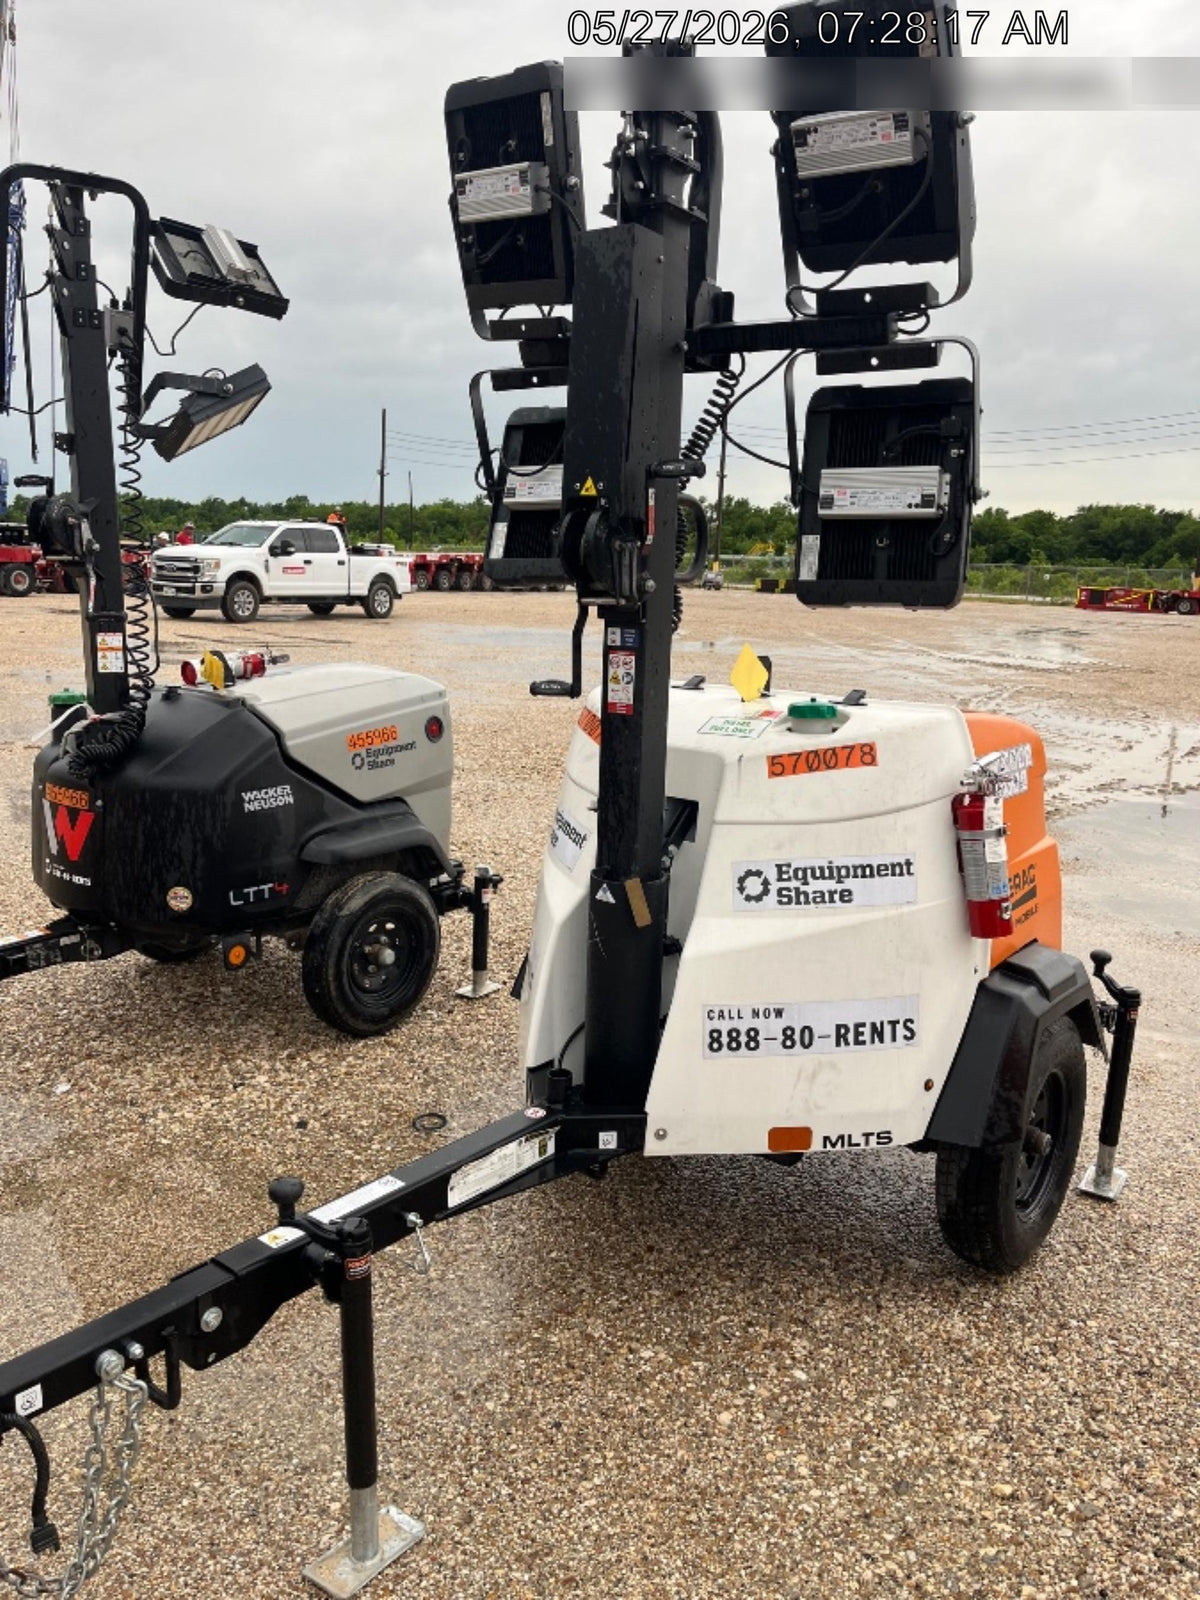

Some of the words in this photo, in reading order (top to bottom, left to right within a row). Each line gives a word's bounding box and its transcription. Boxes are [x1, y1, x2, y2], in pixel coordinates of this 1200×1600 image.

[348, 725, 398, 749] 455966
[770, 742, 877, 777] 570078
[241, 785, 293, 802] WACKER
[243, 794, 295, 813] NEUSON
[775, 858, 915, 886] Equipment
[776, 886, 854, 906] Share
[707, 1008, 744, 1021] CALL
[751, 1007, 785, 1020] NOW
[707, 1018, 917, 1053] 888-80-RENTS
[822, 1130, 894, 1149] MLTS
